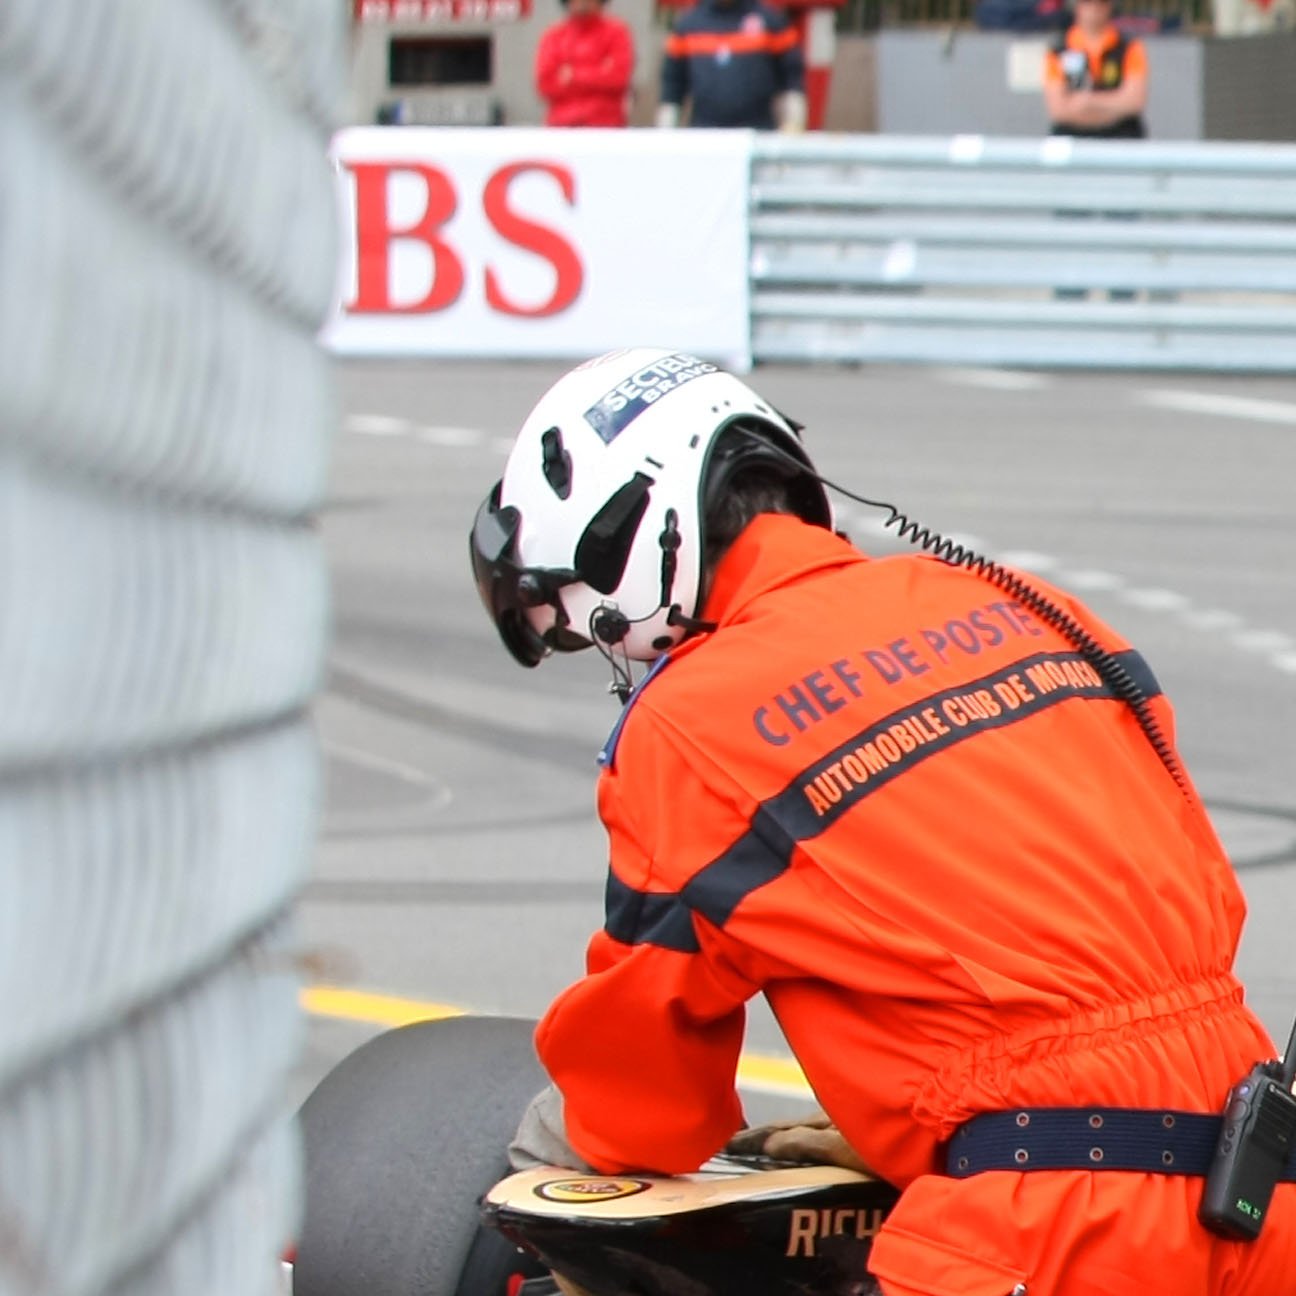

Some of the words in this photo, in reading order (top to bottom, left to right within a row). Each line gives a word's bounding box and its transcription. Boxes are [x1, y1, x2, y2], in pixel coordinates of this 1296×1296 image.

[752, 658, 863, 747] CHEF
[863, 637, 931, 684] DE
[919, 600, 1043, 665] POSTE
[802, 706, 951, 816] AUTOMOBILE
[941, 688, 1001, 726] CLUB
[993, 674, 1036, 710] DE
